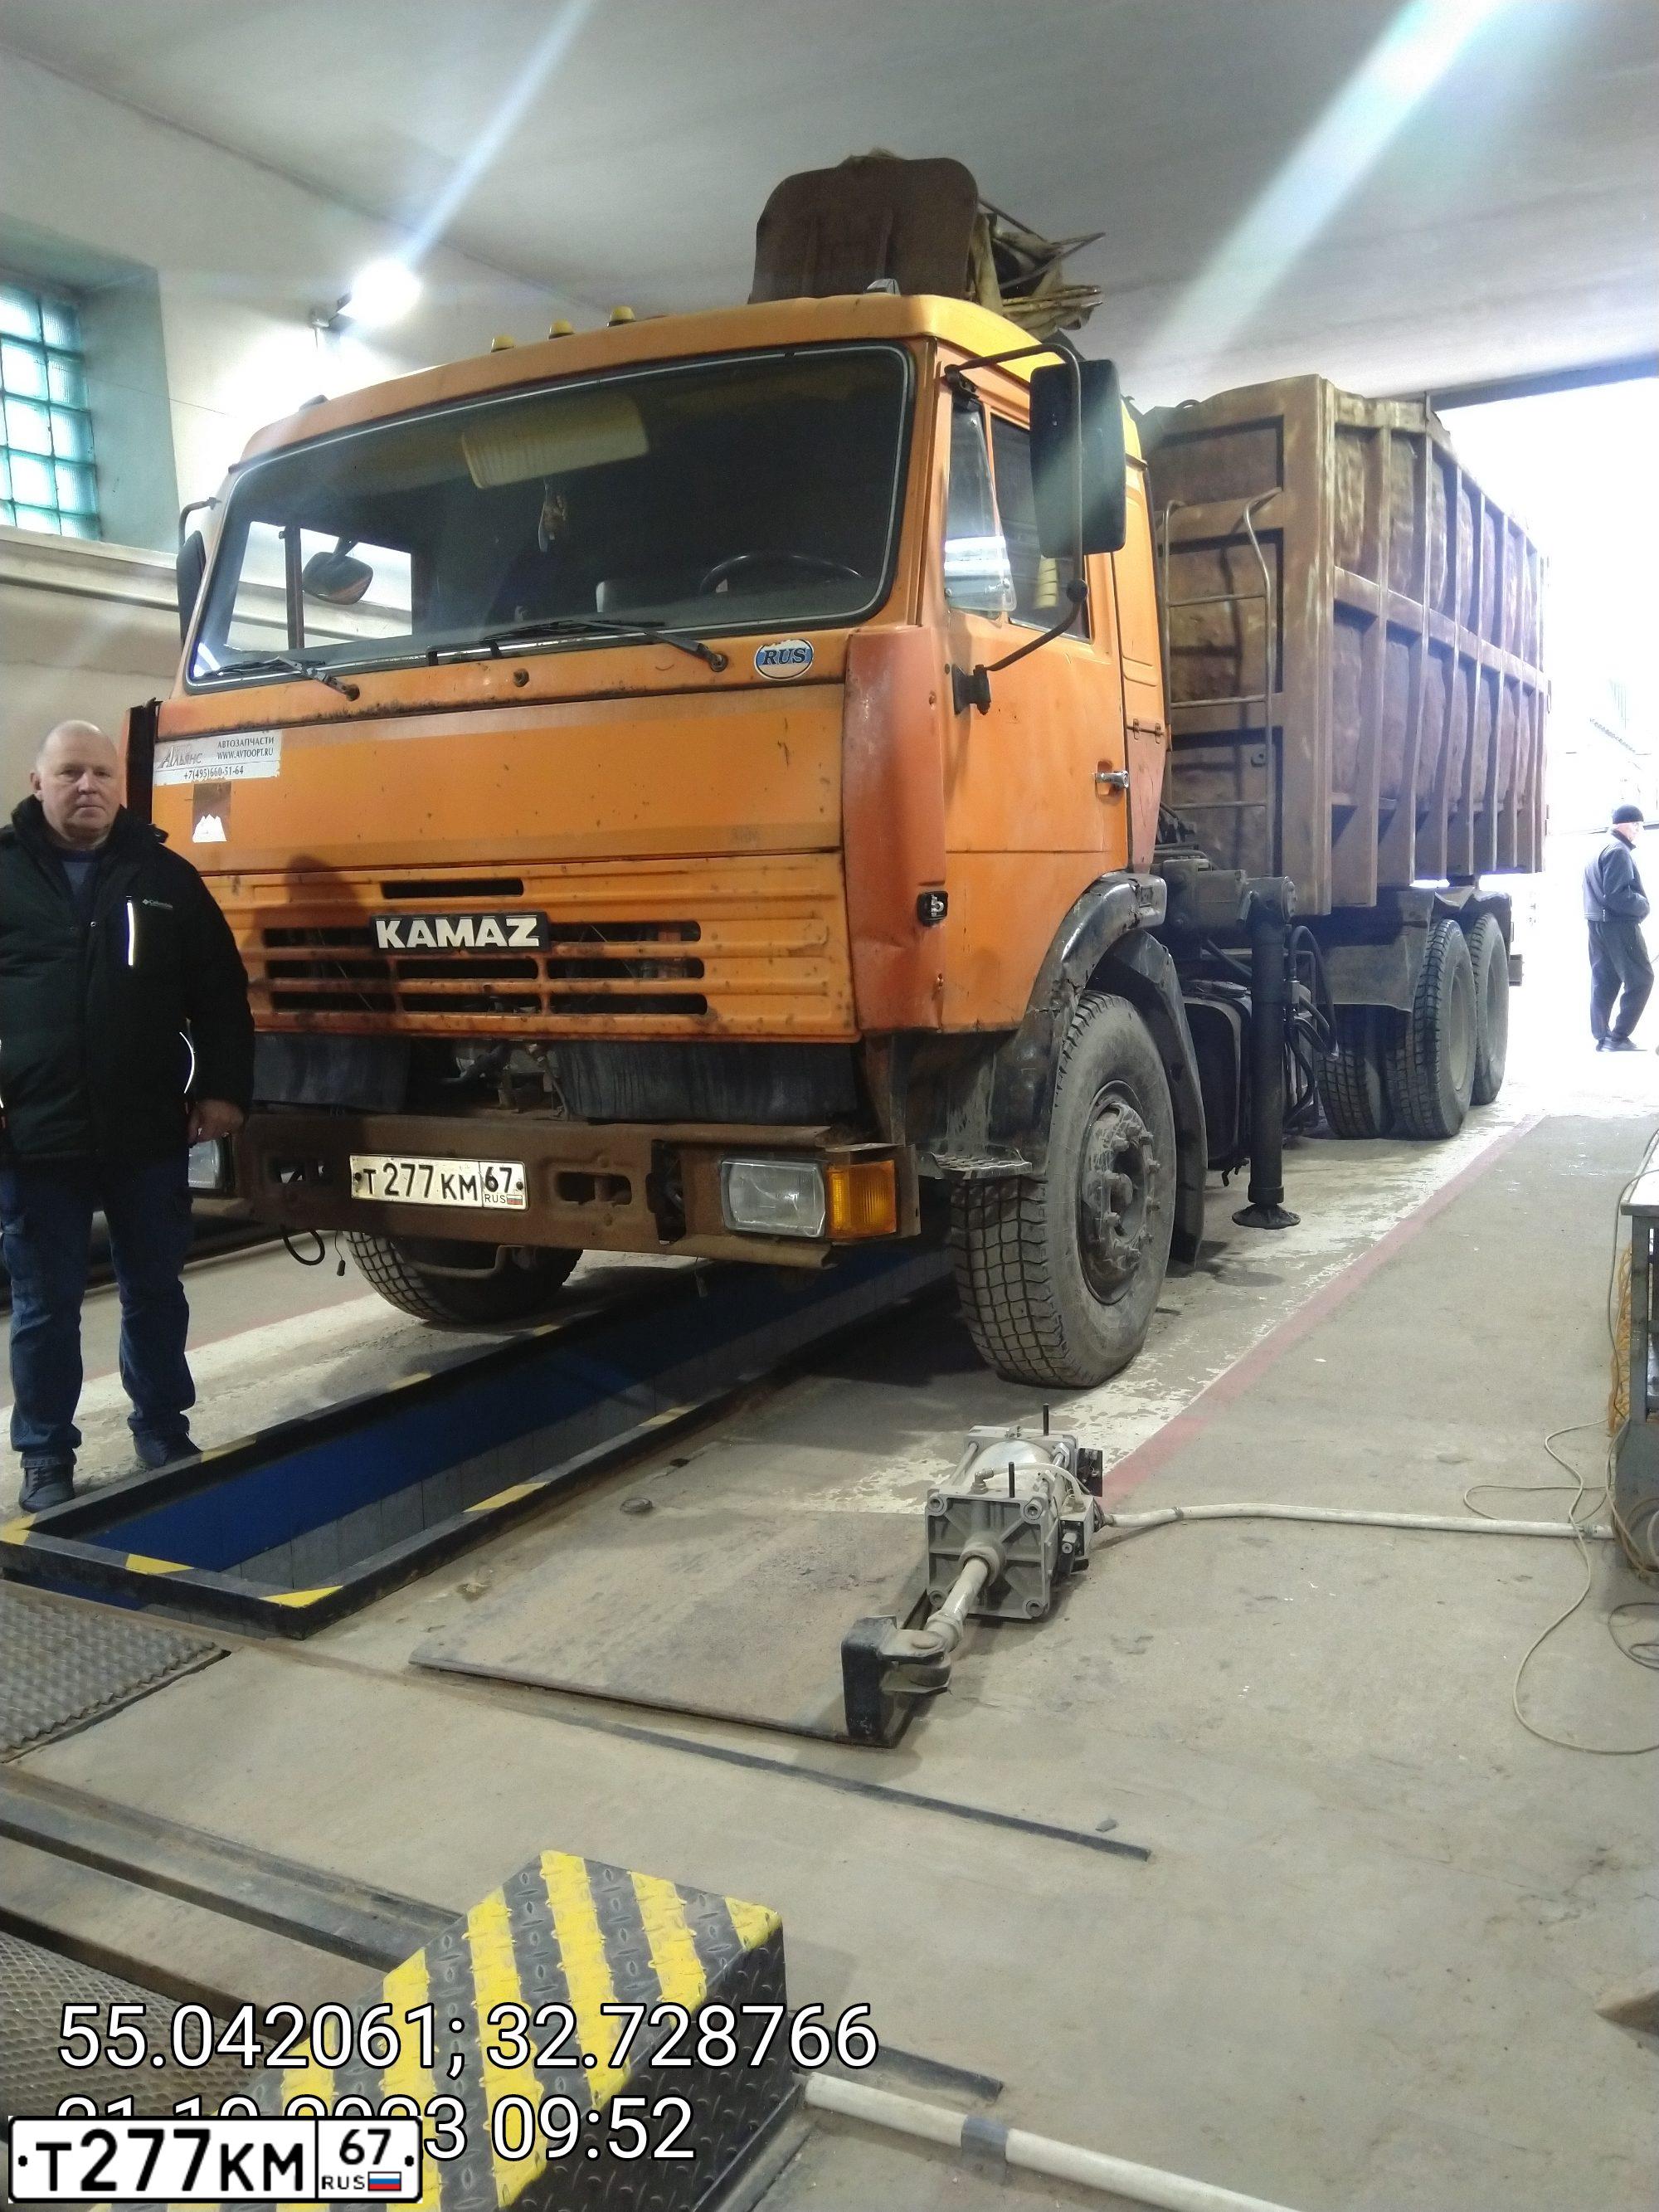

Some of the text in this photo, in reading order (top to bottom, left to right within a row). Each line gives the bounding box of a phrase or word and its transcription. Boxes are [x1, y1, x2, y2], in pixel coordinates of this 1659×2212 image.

[761, 647, 806, 665] RUS
[217, 737, 275, 748] АВТОЗАПЧАСТИ
[216, 748, 274, 760] WWW.AVTOOPT.RU
[375, 916, 539, 949] KAMAZ
[484, 1166, 513, 1194] 67
[484, 1193, 506, 1204] RUS
